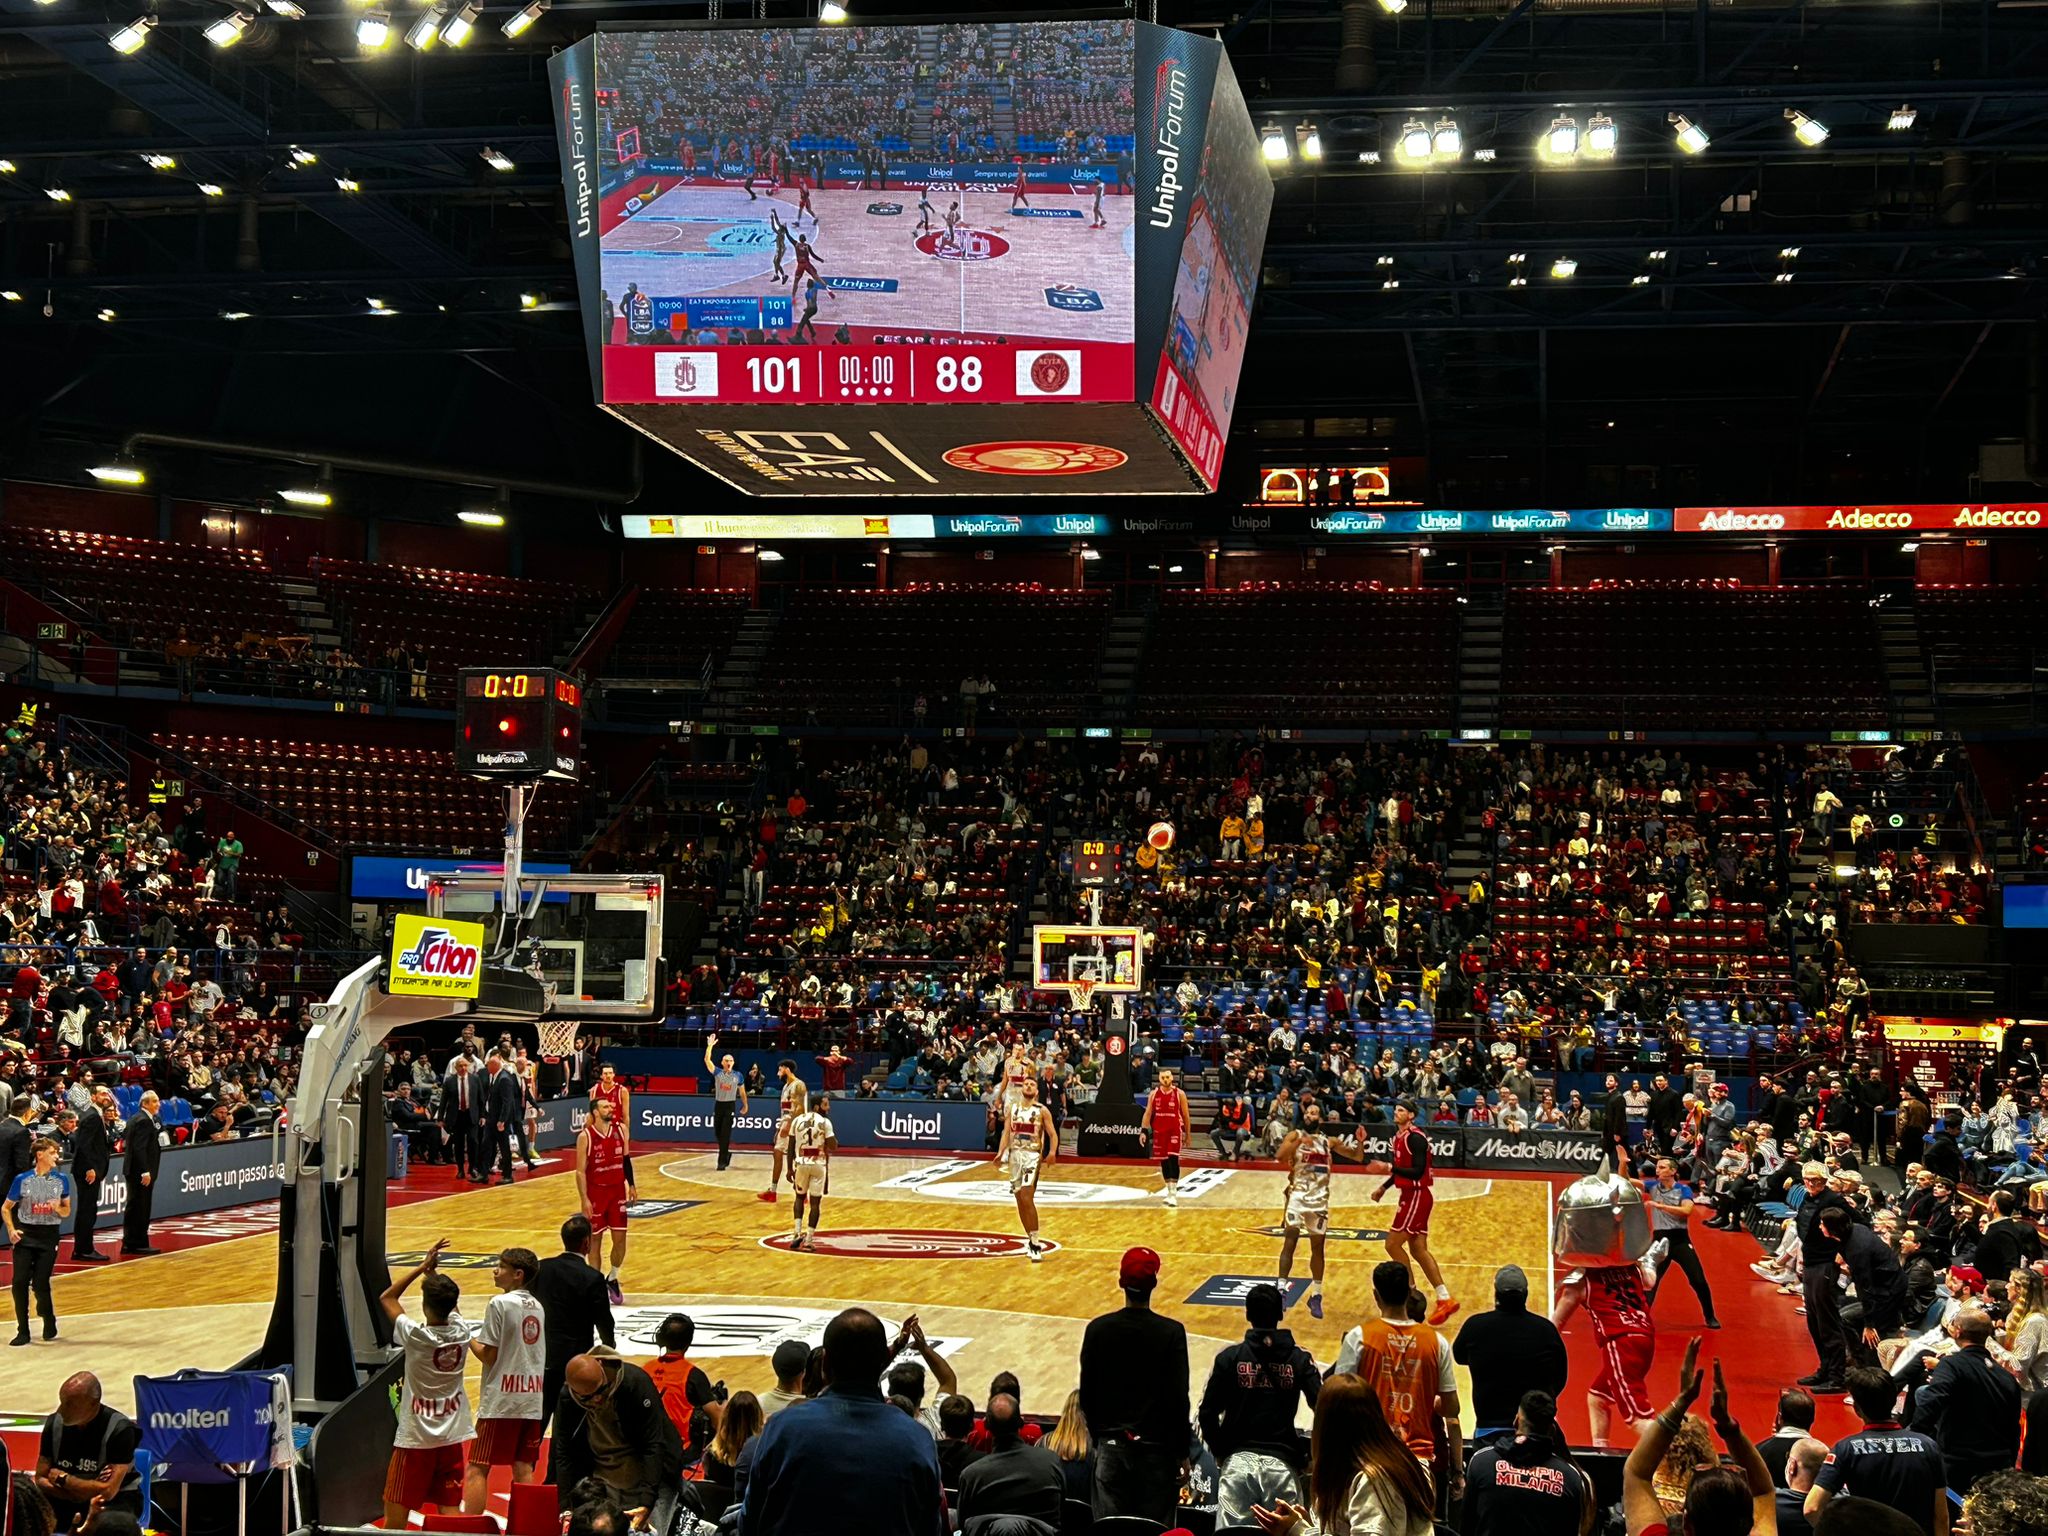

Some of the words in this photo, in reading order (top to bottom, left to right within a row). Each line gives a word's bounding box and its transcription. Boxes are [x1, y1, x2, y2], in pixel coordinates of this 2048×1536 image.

[1150, 69, 1187, 229] UnipolForum
[571, 84, 592, 238] UnipolForum
[927, 166, 954, 179] Unipol
[768, 300, 787, 310] 101
[747, 356, 802, 393] 101
[839, 355, 894, 385] 00:00
[936, 356, 983, 393] 88
[951, 516, 1020, 535] UnipolForum
[1054, 516, 1095, 534] Unipol
[1124, 518, 1193, 533] UnipolForum
[1232, 515, 1271, 532] Unipol
[1311, 516, 1383, 534] UnipolForum
[1417, 512, 1463, 531] Unipol
[1492, 513, 1568, 532] UnipolForum
[1603, 511, 1650, 530] Unipol
[1699, 510, 1785, 531] Adecco
[1826, 508, 1913, 529] Adecco
[1953, 506, 2041, 528] Adecco
[400, 953, 420, 964] PRO
[408, 929, 477, 976] Action
[641, 1109, 701, 1132] Sempre
[875, 1111, 942, 1140] Unipol
[1474, 1138, 1537, 1159] Media
[180, 1169, 222, 1196] Sempre
[223, 1168, 237, 1186] un
[238, 1165, 267, 1191] passo
[151, 1408, 230, 1430] molten
[1850, 1437, 1925, 1455] REYER
[1496, 1460, 1564, 1484] OLIMPIA
[1496, 1472, 1564, 1497] MILANO
